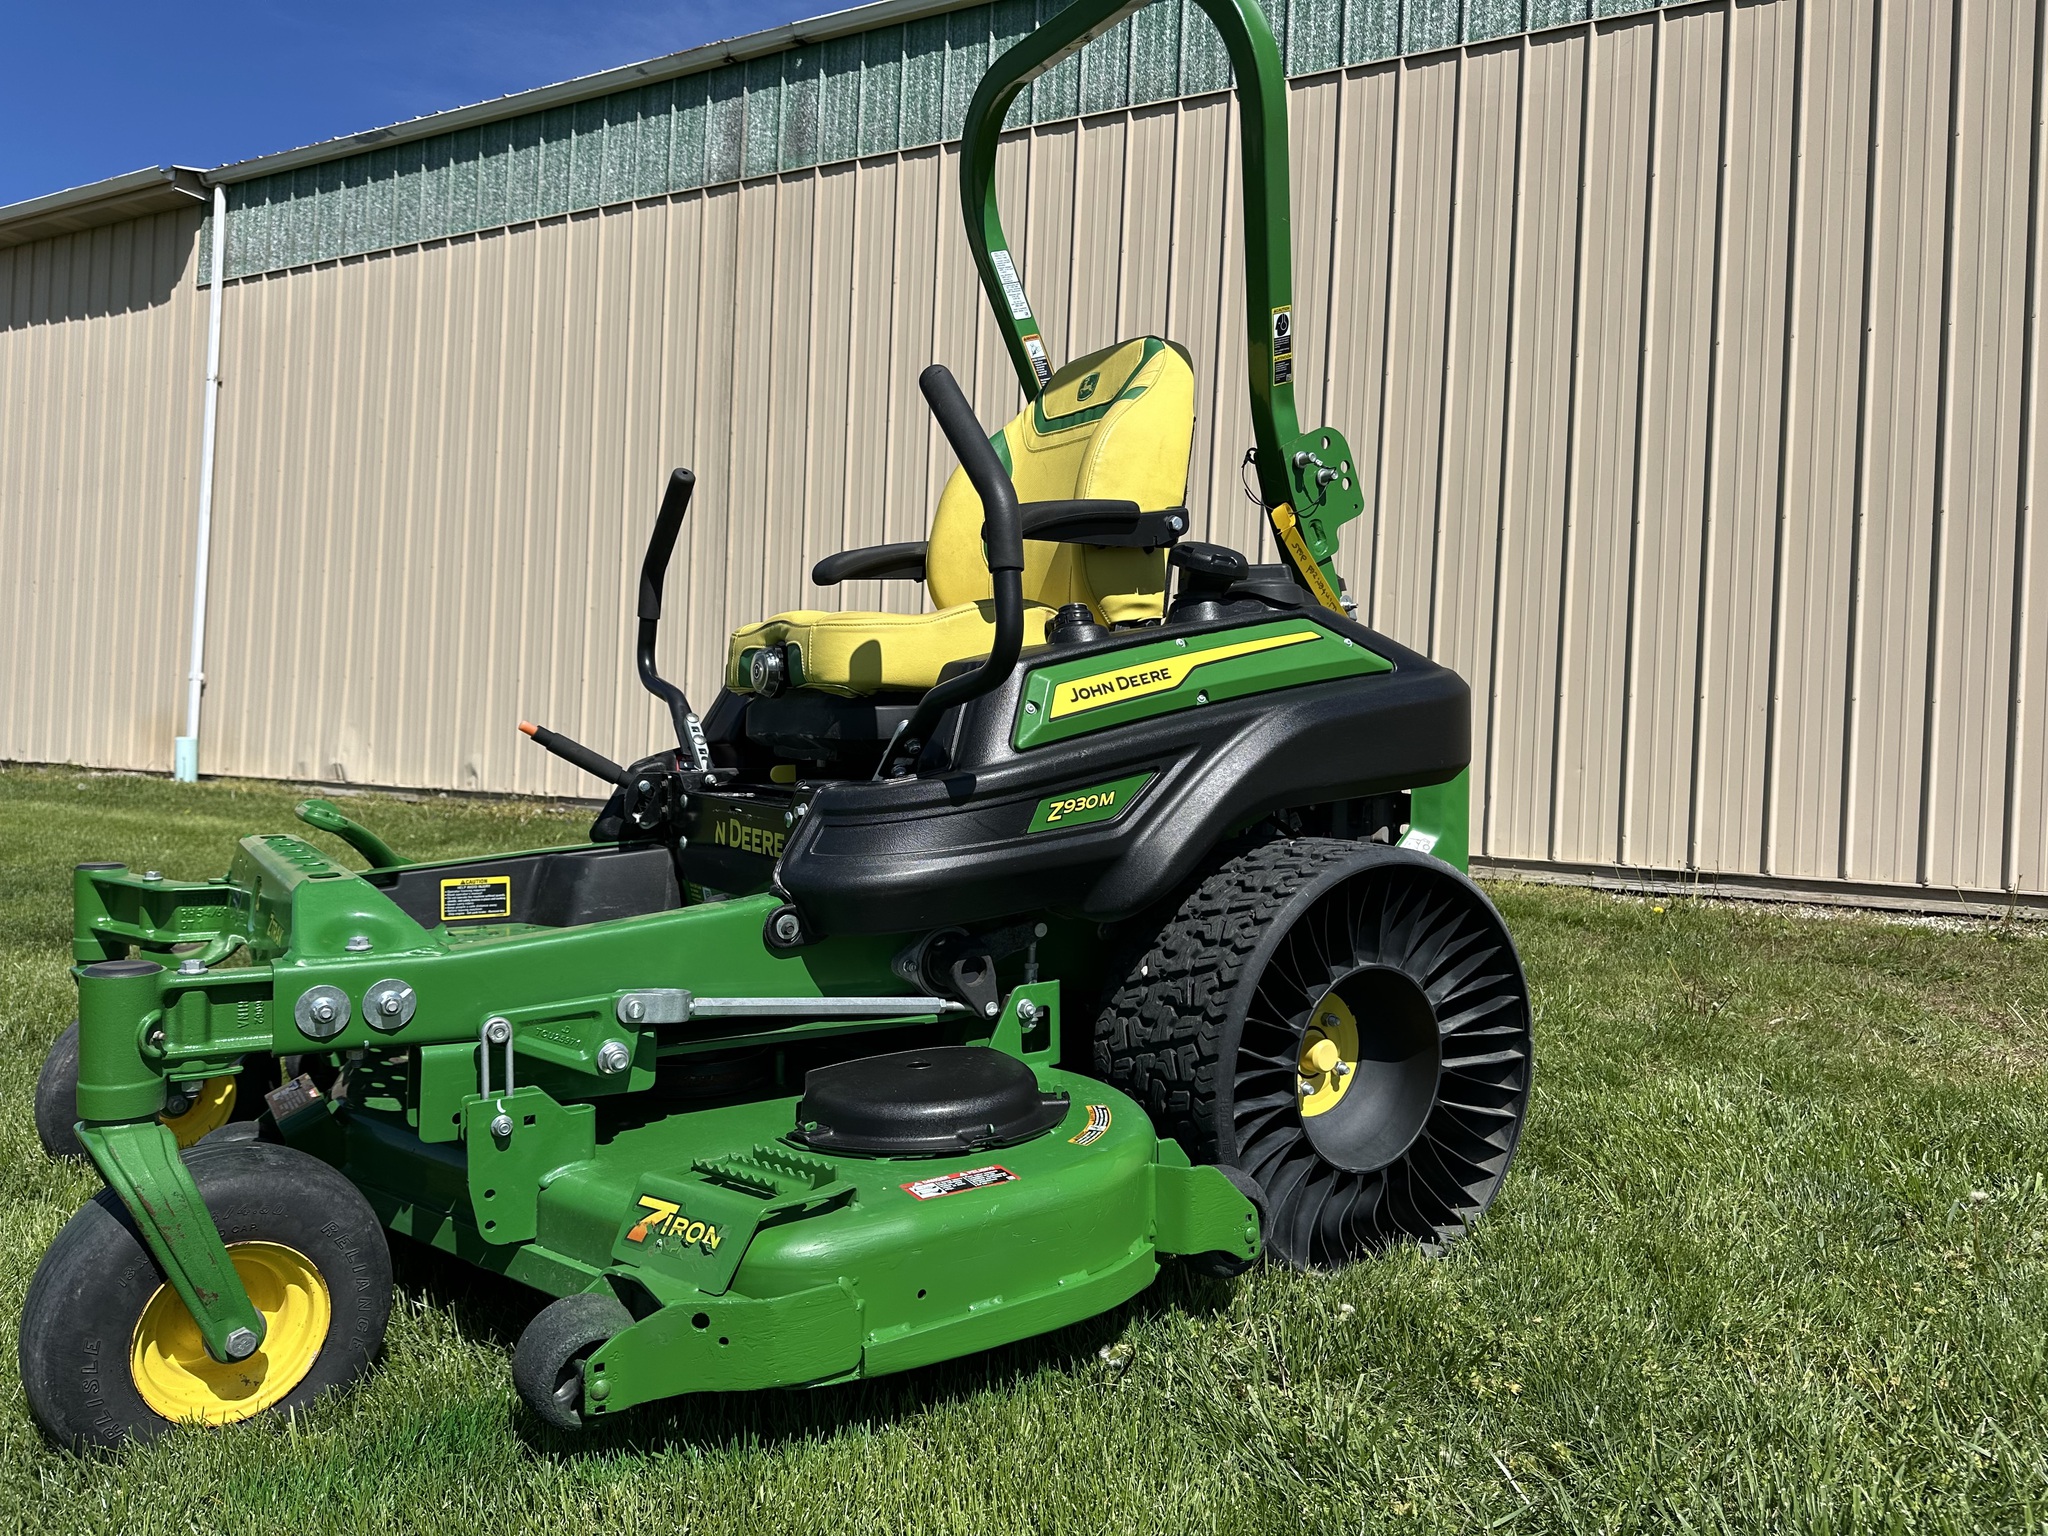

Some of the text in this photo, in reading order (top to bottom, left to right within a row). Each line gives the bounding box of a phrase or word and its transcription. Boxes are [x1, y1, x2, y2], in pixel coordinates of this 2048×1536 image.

[1070, 667, 1172, 703] JOHN DEERE
[1046, 791, 1116, 822] Z930M
[729, 818, 785, 858] DEERE
[237, 1001, 249, 1029] HINA
[319, 1221, 374, 1354] RELIANCE
[81, 1337, 124, 1442] RLISLE
